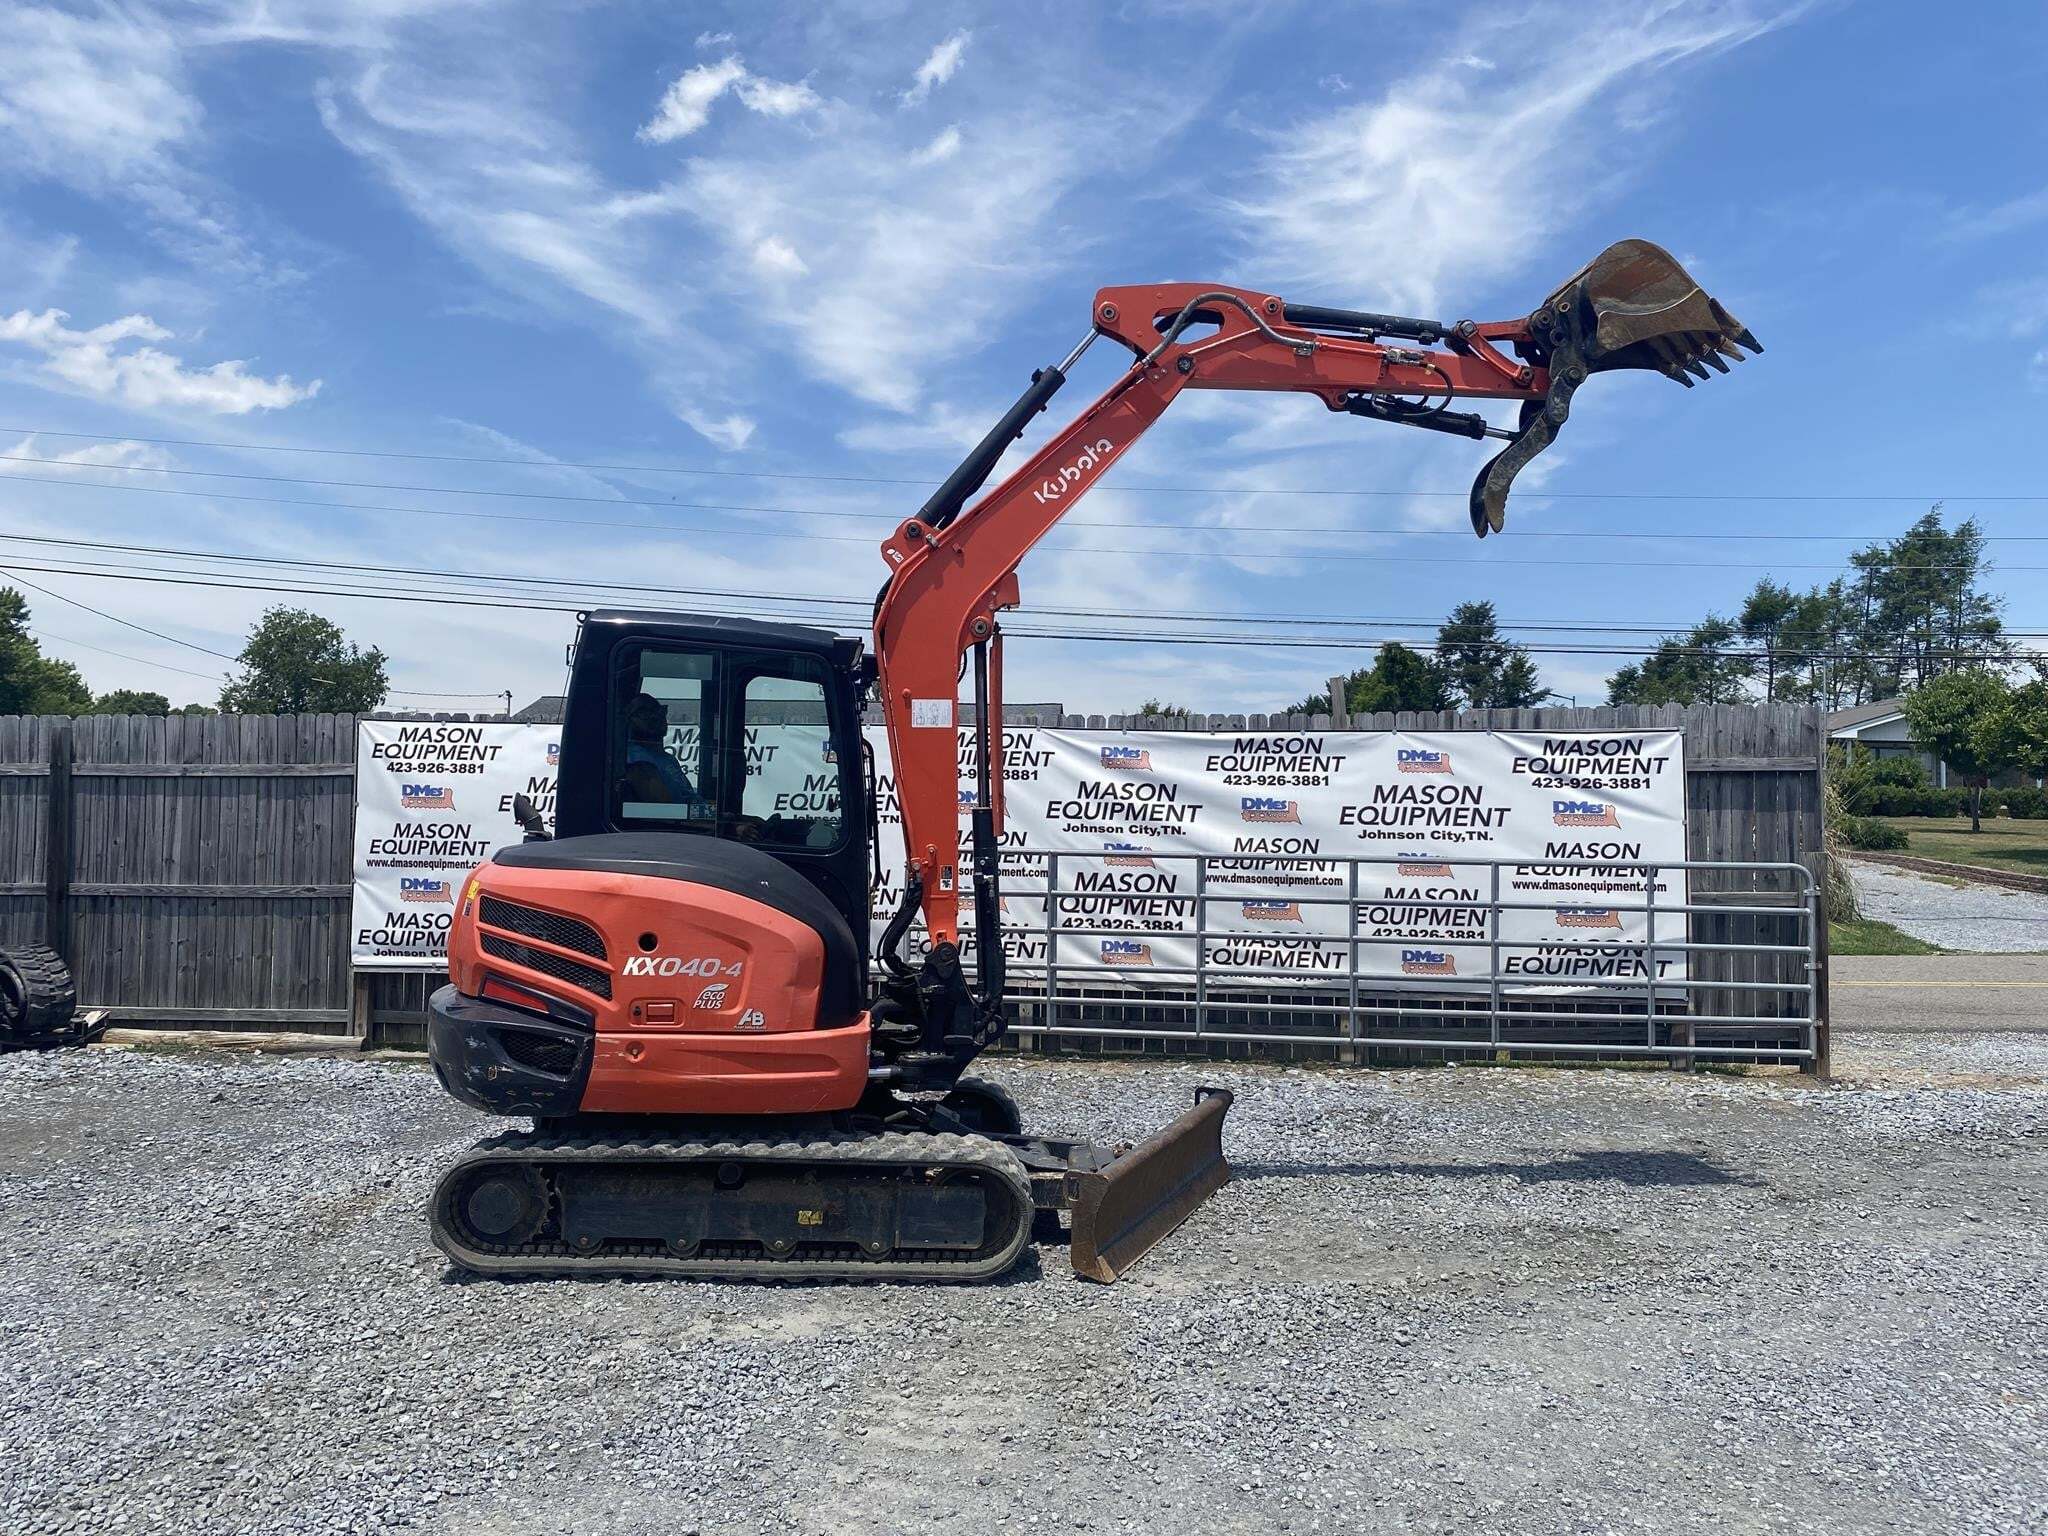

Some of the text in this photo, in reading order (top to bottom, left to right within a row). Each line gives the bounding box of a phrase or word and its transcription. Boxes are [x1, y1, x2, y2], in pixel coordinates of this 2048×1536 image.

[1033, 439, 1113, 504] Kubota
[398, 727, 483, 743] MASON
[371, 743, 502, 761] EQUIPMENT
[1233, 737, 1324, 754] MASON
[1543, 739, 1643, 756] MASON
[386, 762, 485, 774] 423-926-3881
[1205, 755, 1347, 773] EQUIPMENT
[1512, 756, 1669, 775] EQUIPMENT
[1223, 775, 1329, 787] 423-926-3881
[1531, 777, 1651, 790] 423-926-3881
[1078, 781, 1177, 802] MASON
[1372, 784, 1483, 805] MASON
[1045, 801, 1203, 823] EQUIPMENT
[1339, 805, 1511, 828] EQUIPMENT
[393, 823, 471, 839] MASON
[1062, 823, 1187, 838] Johnson City,TN.
[1357, 829, 1494, 842] Johnson City,TN.
[369, 839, 490, 856] EQUIPMENT
[1233, 837, 1320, 855] MASON
[1545, 842, 1641, 860] MASON
[366, 858, 481, 871] www.dmasonequipment.c
[1074, 872, 1177, 893] MASON
[385, 912, 452, 930] MASO
[1062, 917, 1184, 930] 423-926-3881
[358, 929, 451, 946] EQUIPM
[373, 948, 426, 957] Johnson
[622, 956, 743, 977] KX040-4
[704, 990, 726, 1000] eco
[692, 1000, 723, 1009] PLUS
